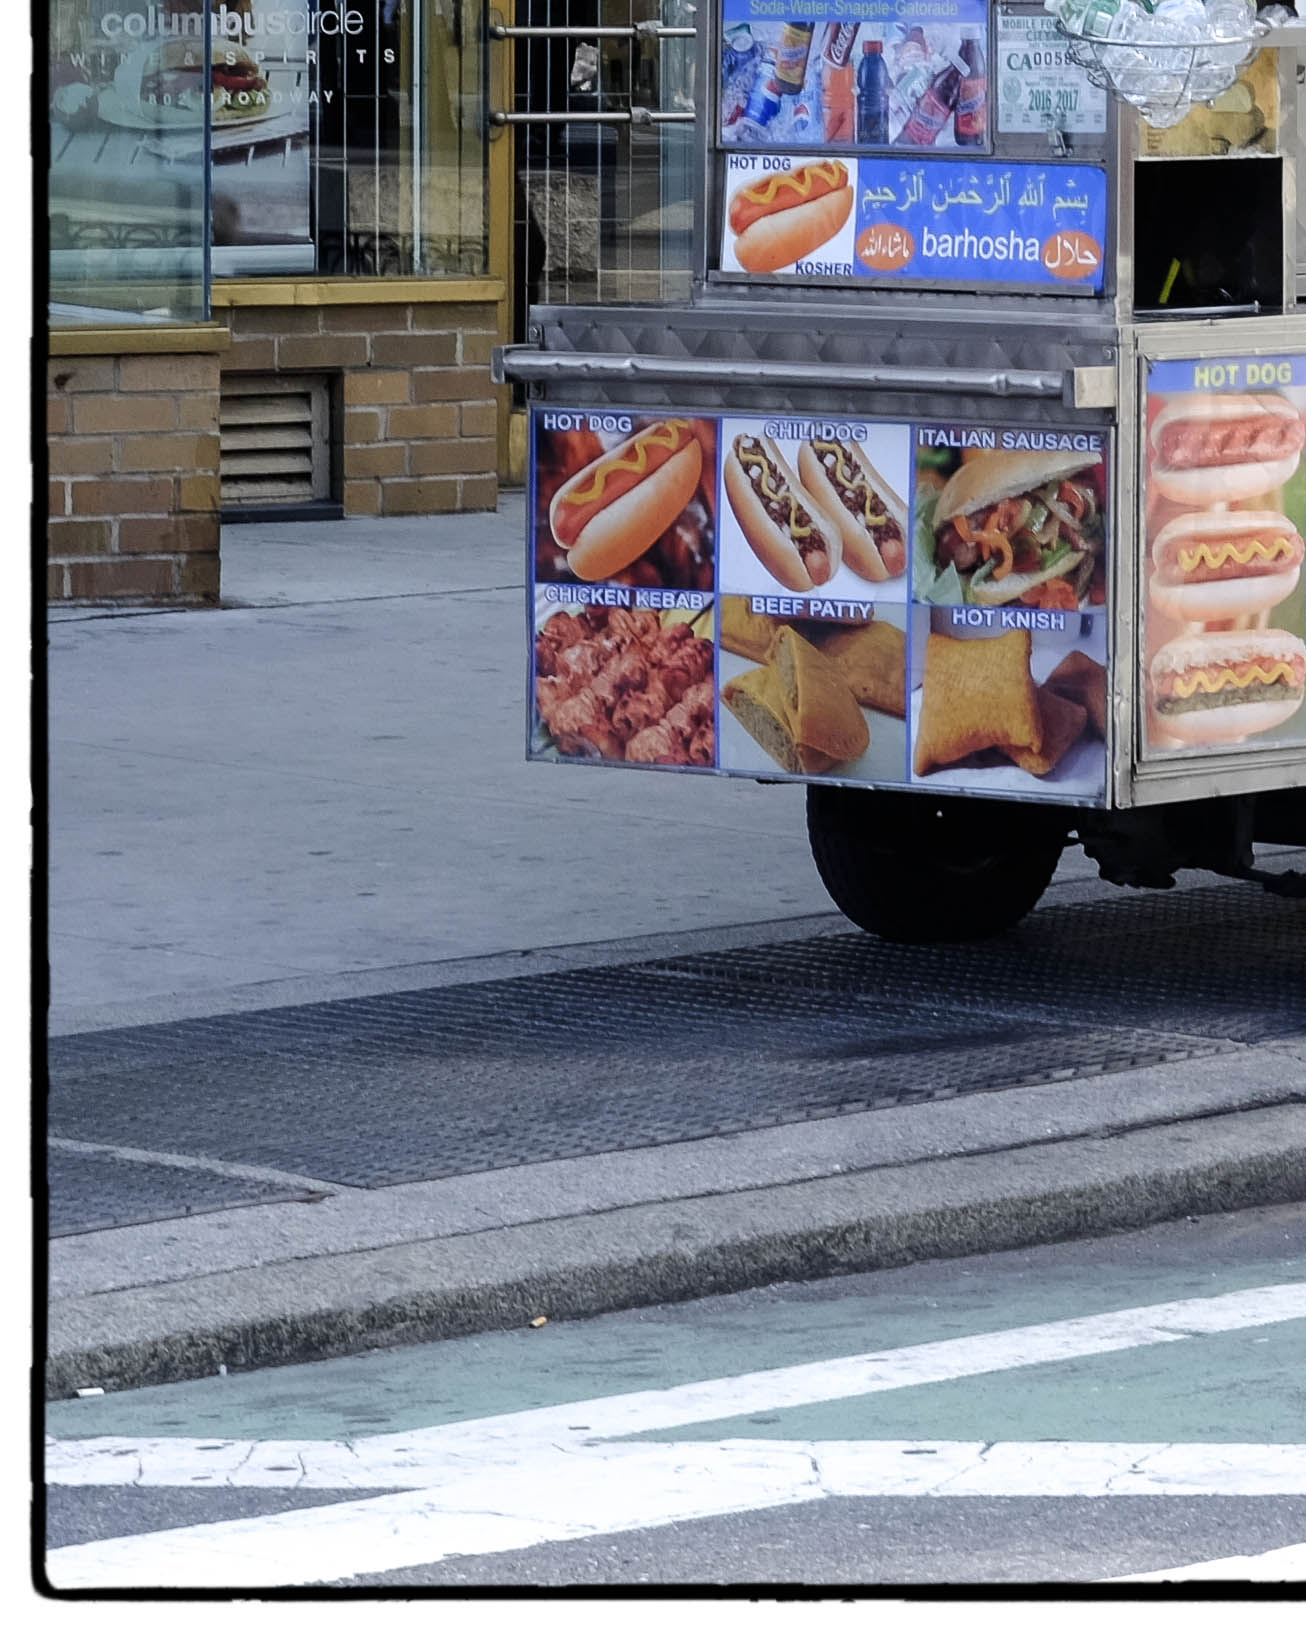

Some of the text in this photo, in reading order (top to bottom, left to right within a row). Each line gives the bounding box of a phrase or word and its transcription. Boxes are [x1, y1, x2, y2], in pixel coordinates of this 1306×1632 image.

[225, 48, 397, 66] SPIRTS
[1006, 53, 1033, 71] CA
[729, 155, 792, 172] HOT DOG
[921, 226, 1040, 262] barhosha
[1044, 235, 1099, 269] حلال
[794, 261, 855, 276] KOSHER
[1194, 362, 1292, 388] HOT DOG
[543, 413, 633, 434] HOT DOG
[764, 421, 868, 443] CHILI DOG
[917, 428, 1101, 454] ITALIAN SAUSAGE
[544, 585, 704, 611] CHICKEN KEBAB
[751, 596, 874, 621] BEEF PATTY
[952, 607, 1067, 631] HOT KNISH
